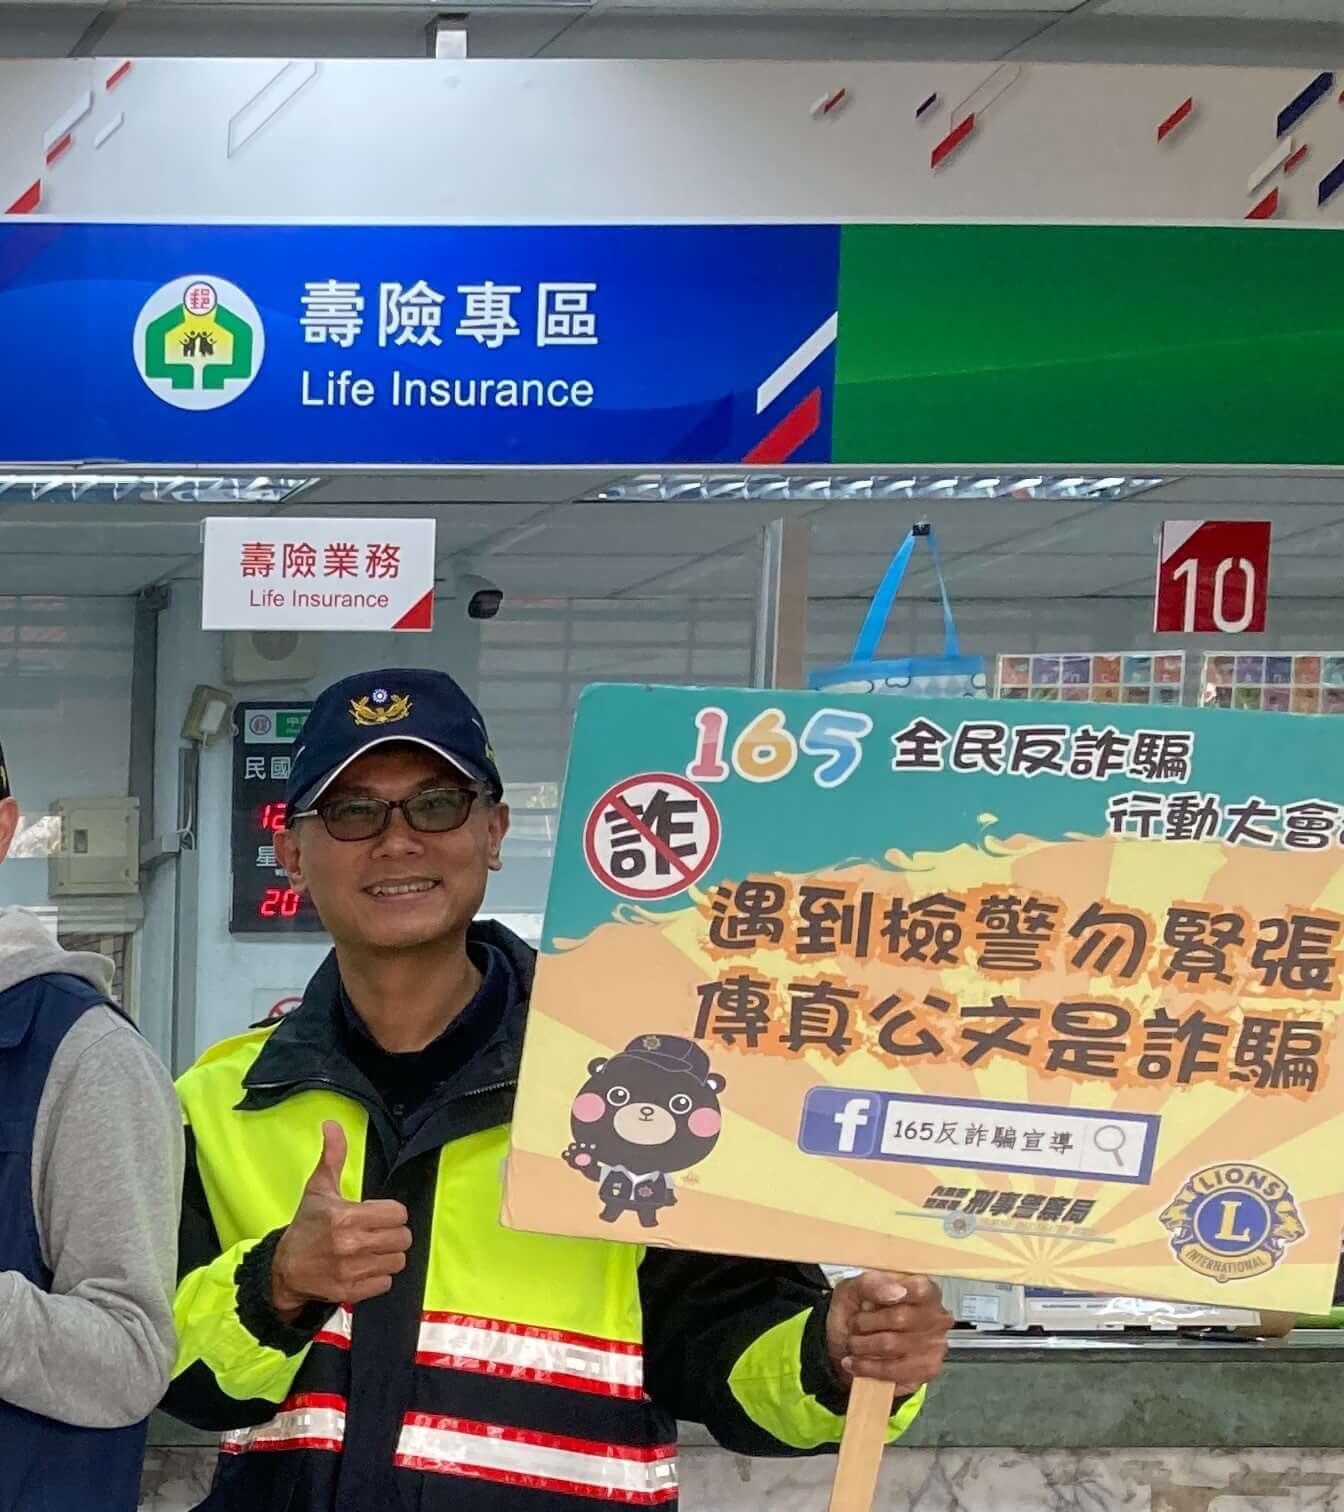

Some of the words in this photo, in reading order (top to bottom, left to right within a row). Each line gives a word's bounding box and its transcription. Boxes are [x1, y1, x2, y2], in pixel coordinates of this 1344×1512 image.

[300, 279, 598, 348] 壽險專區
[301, 370, 375, 407] Life
[392, 370, 594, 407] Insurance
[240, 542, 401, 579] 壽險業務
[250, 589, 285, 608] Life
[292, 589, 389, 608] Insurance
[1173, 557, 1255, 633] 10
[686, 707, 874, 788] 165
[893, 718, 1192, 782] 全民反詐騙
[605, 791, 698, 879] 詐
[1109, 793, 1344, 850] 行動大會
[709, 882, 1340, 993] 遇到檢警勿緊張
[694, 974, 1324, 1092] 傳真公文是詐騙
[892, 1119, 1075, 1156] 165反詐騙宣導
[1199, 1168, 1281, 1196] LIONS
[1215, 1200, 1250, 1242] L
[1185, 1248, 1267, 1273] INTERNATIONAL
